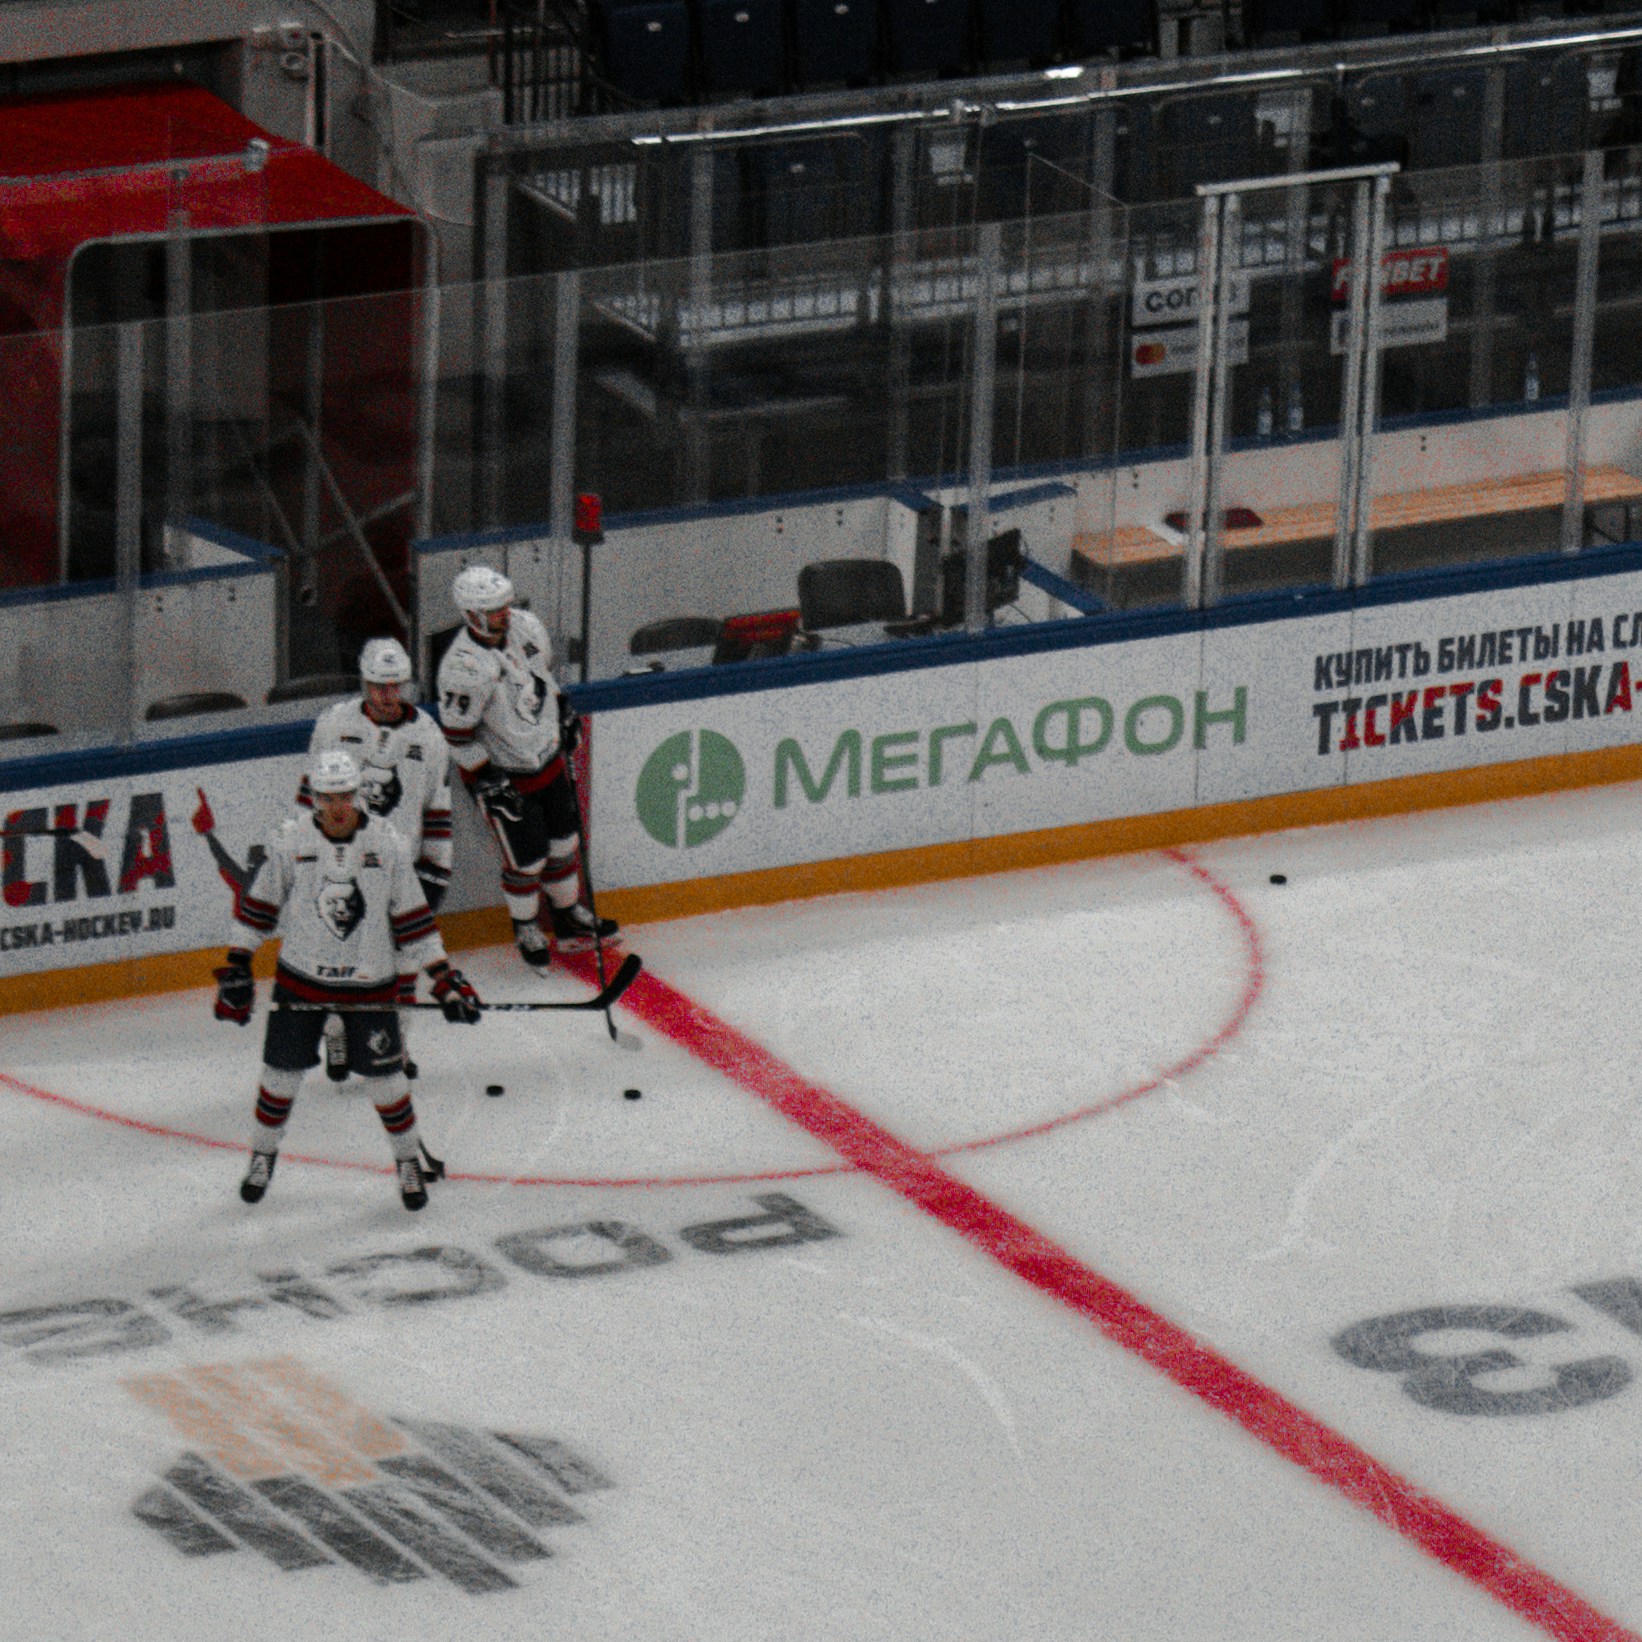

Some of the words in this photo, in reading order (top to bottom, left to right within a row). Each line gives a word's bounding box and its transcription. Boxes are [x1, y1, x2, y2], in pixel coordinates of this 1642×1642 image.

[1314, 641, 1431, 691] КУПИТЬ
[1437, 623, 1561, 674] БИЛЕТЫ
[1566, 618, 1605, 656] НА
